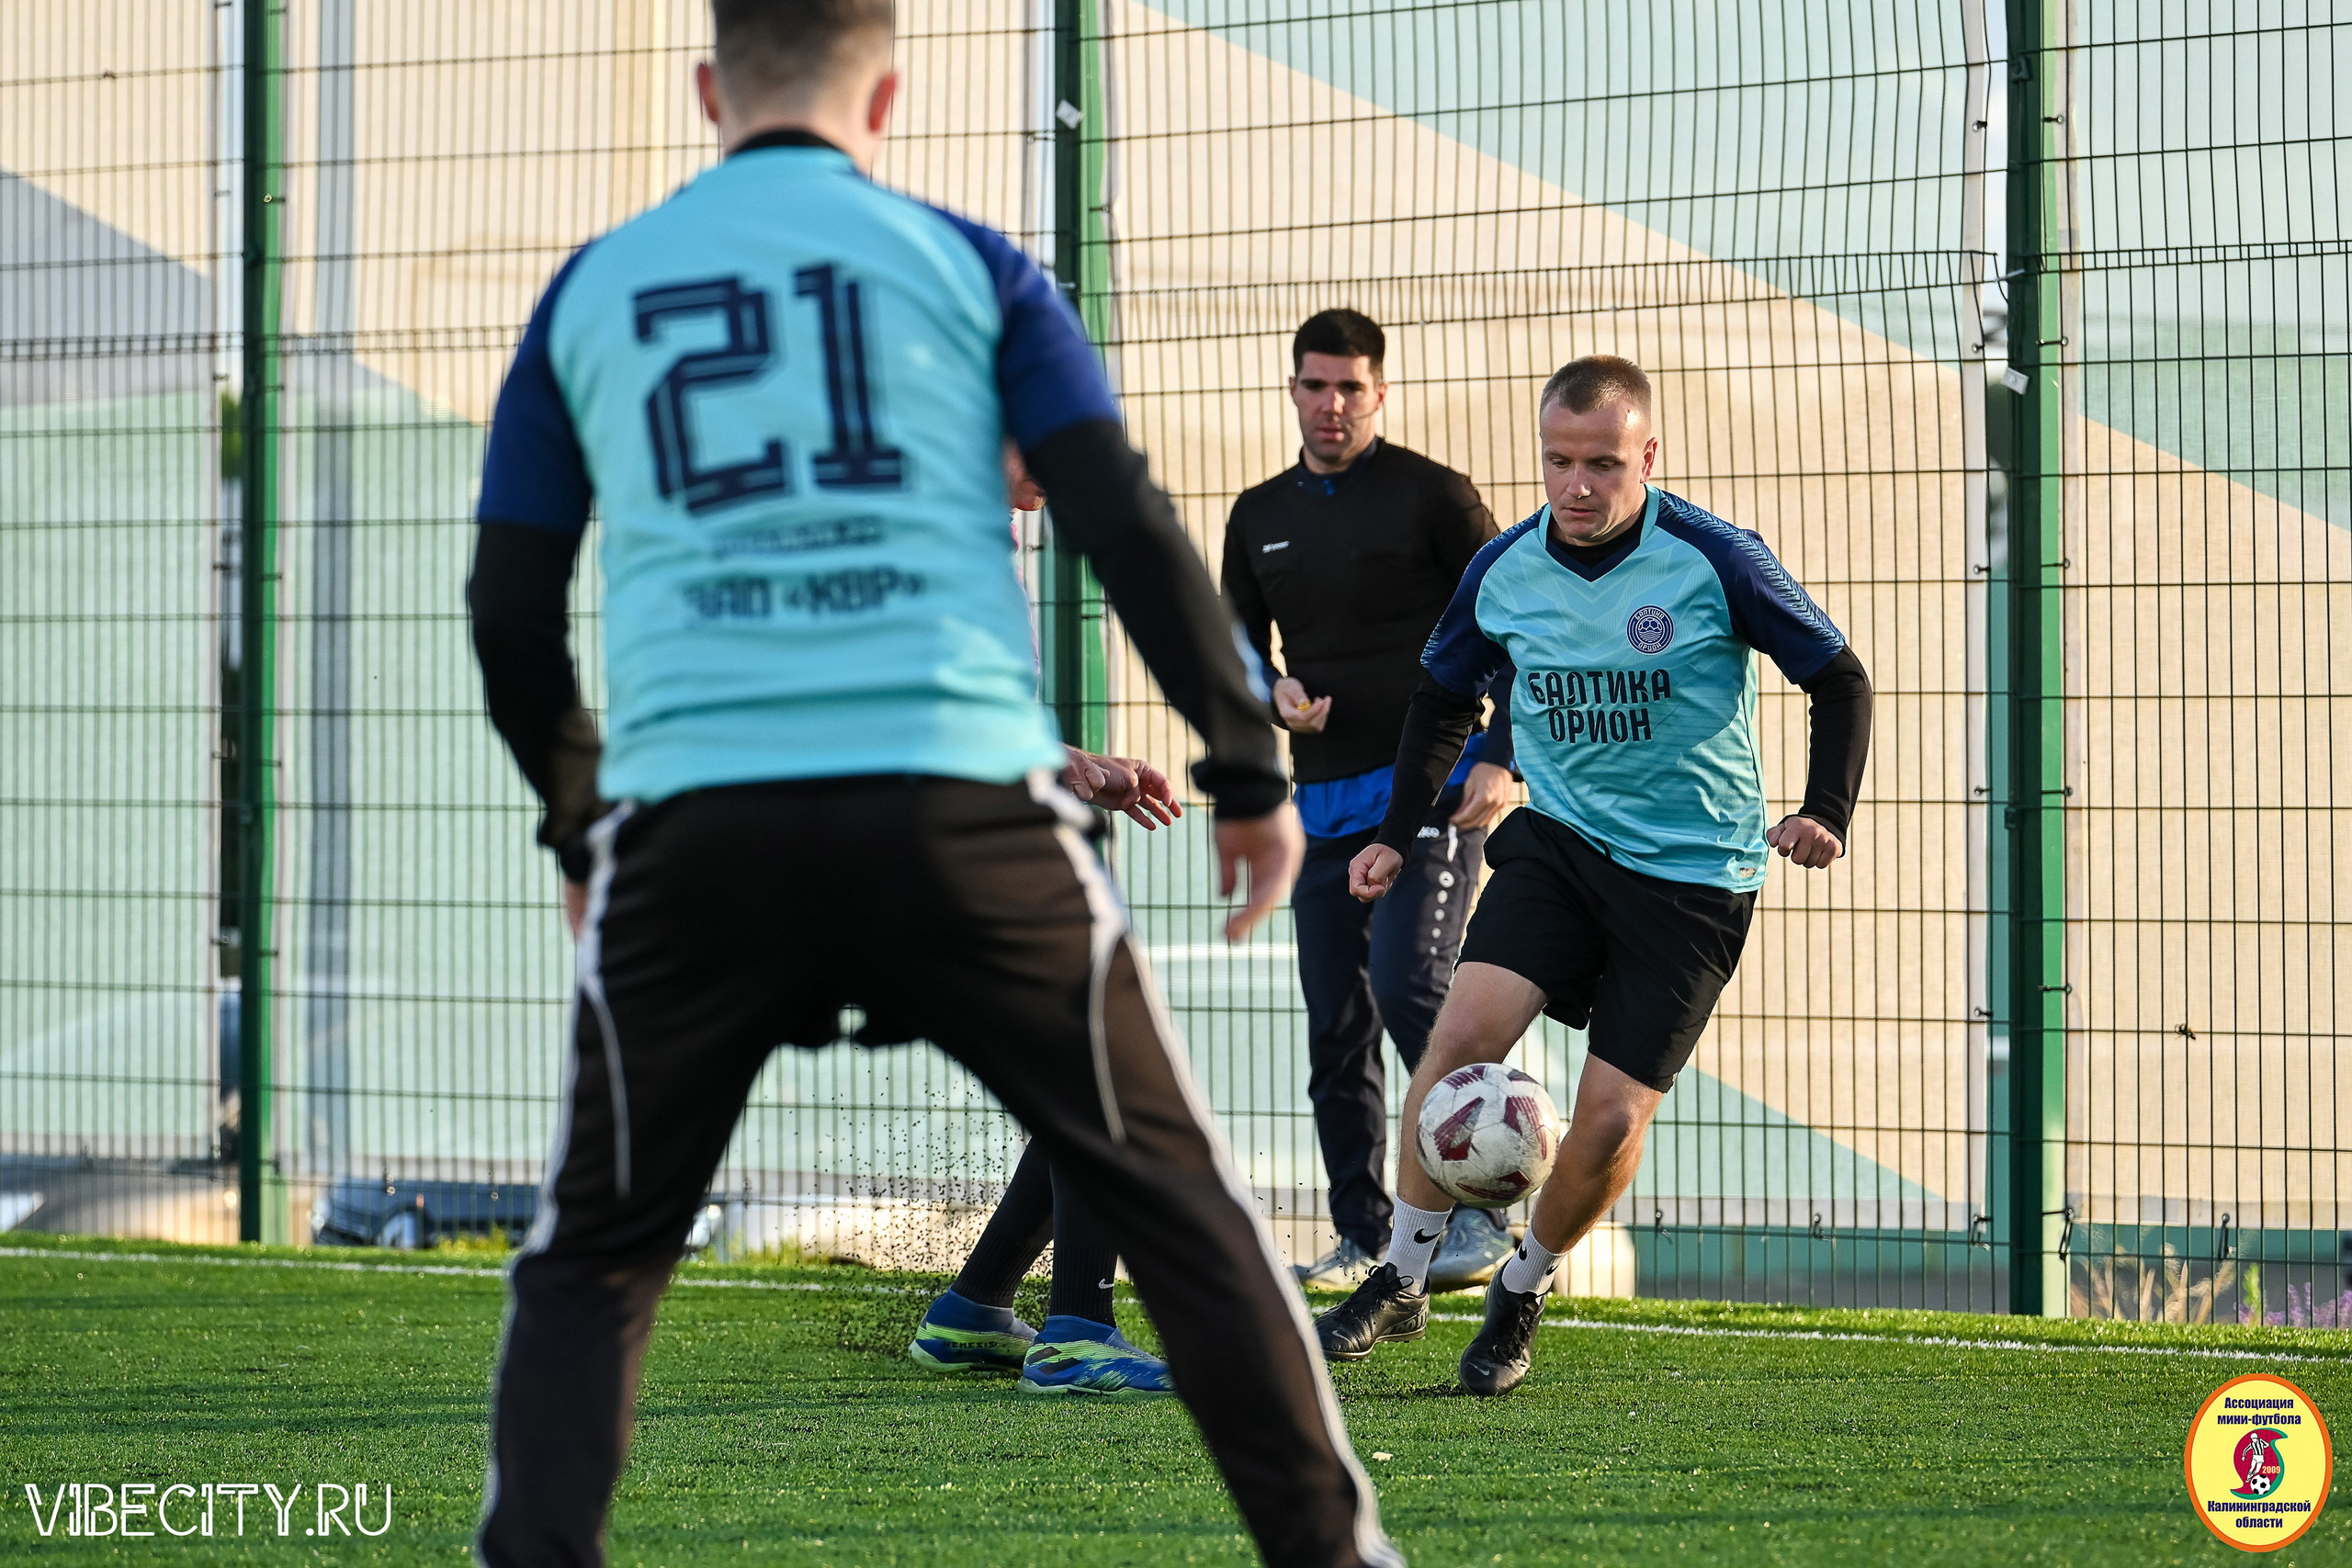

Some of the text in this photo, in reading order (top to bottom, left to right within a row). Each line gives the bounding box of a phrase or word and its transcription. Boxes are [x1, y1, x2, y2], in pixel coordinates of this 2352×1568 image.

[632, 261, 905, 518] 21
[1527, 669, 1671, 706] БАЛТИКА
[1548, 707, 1652, 743] ОРИОН
